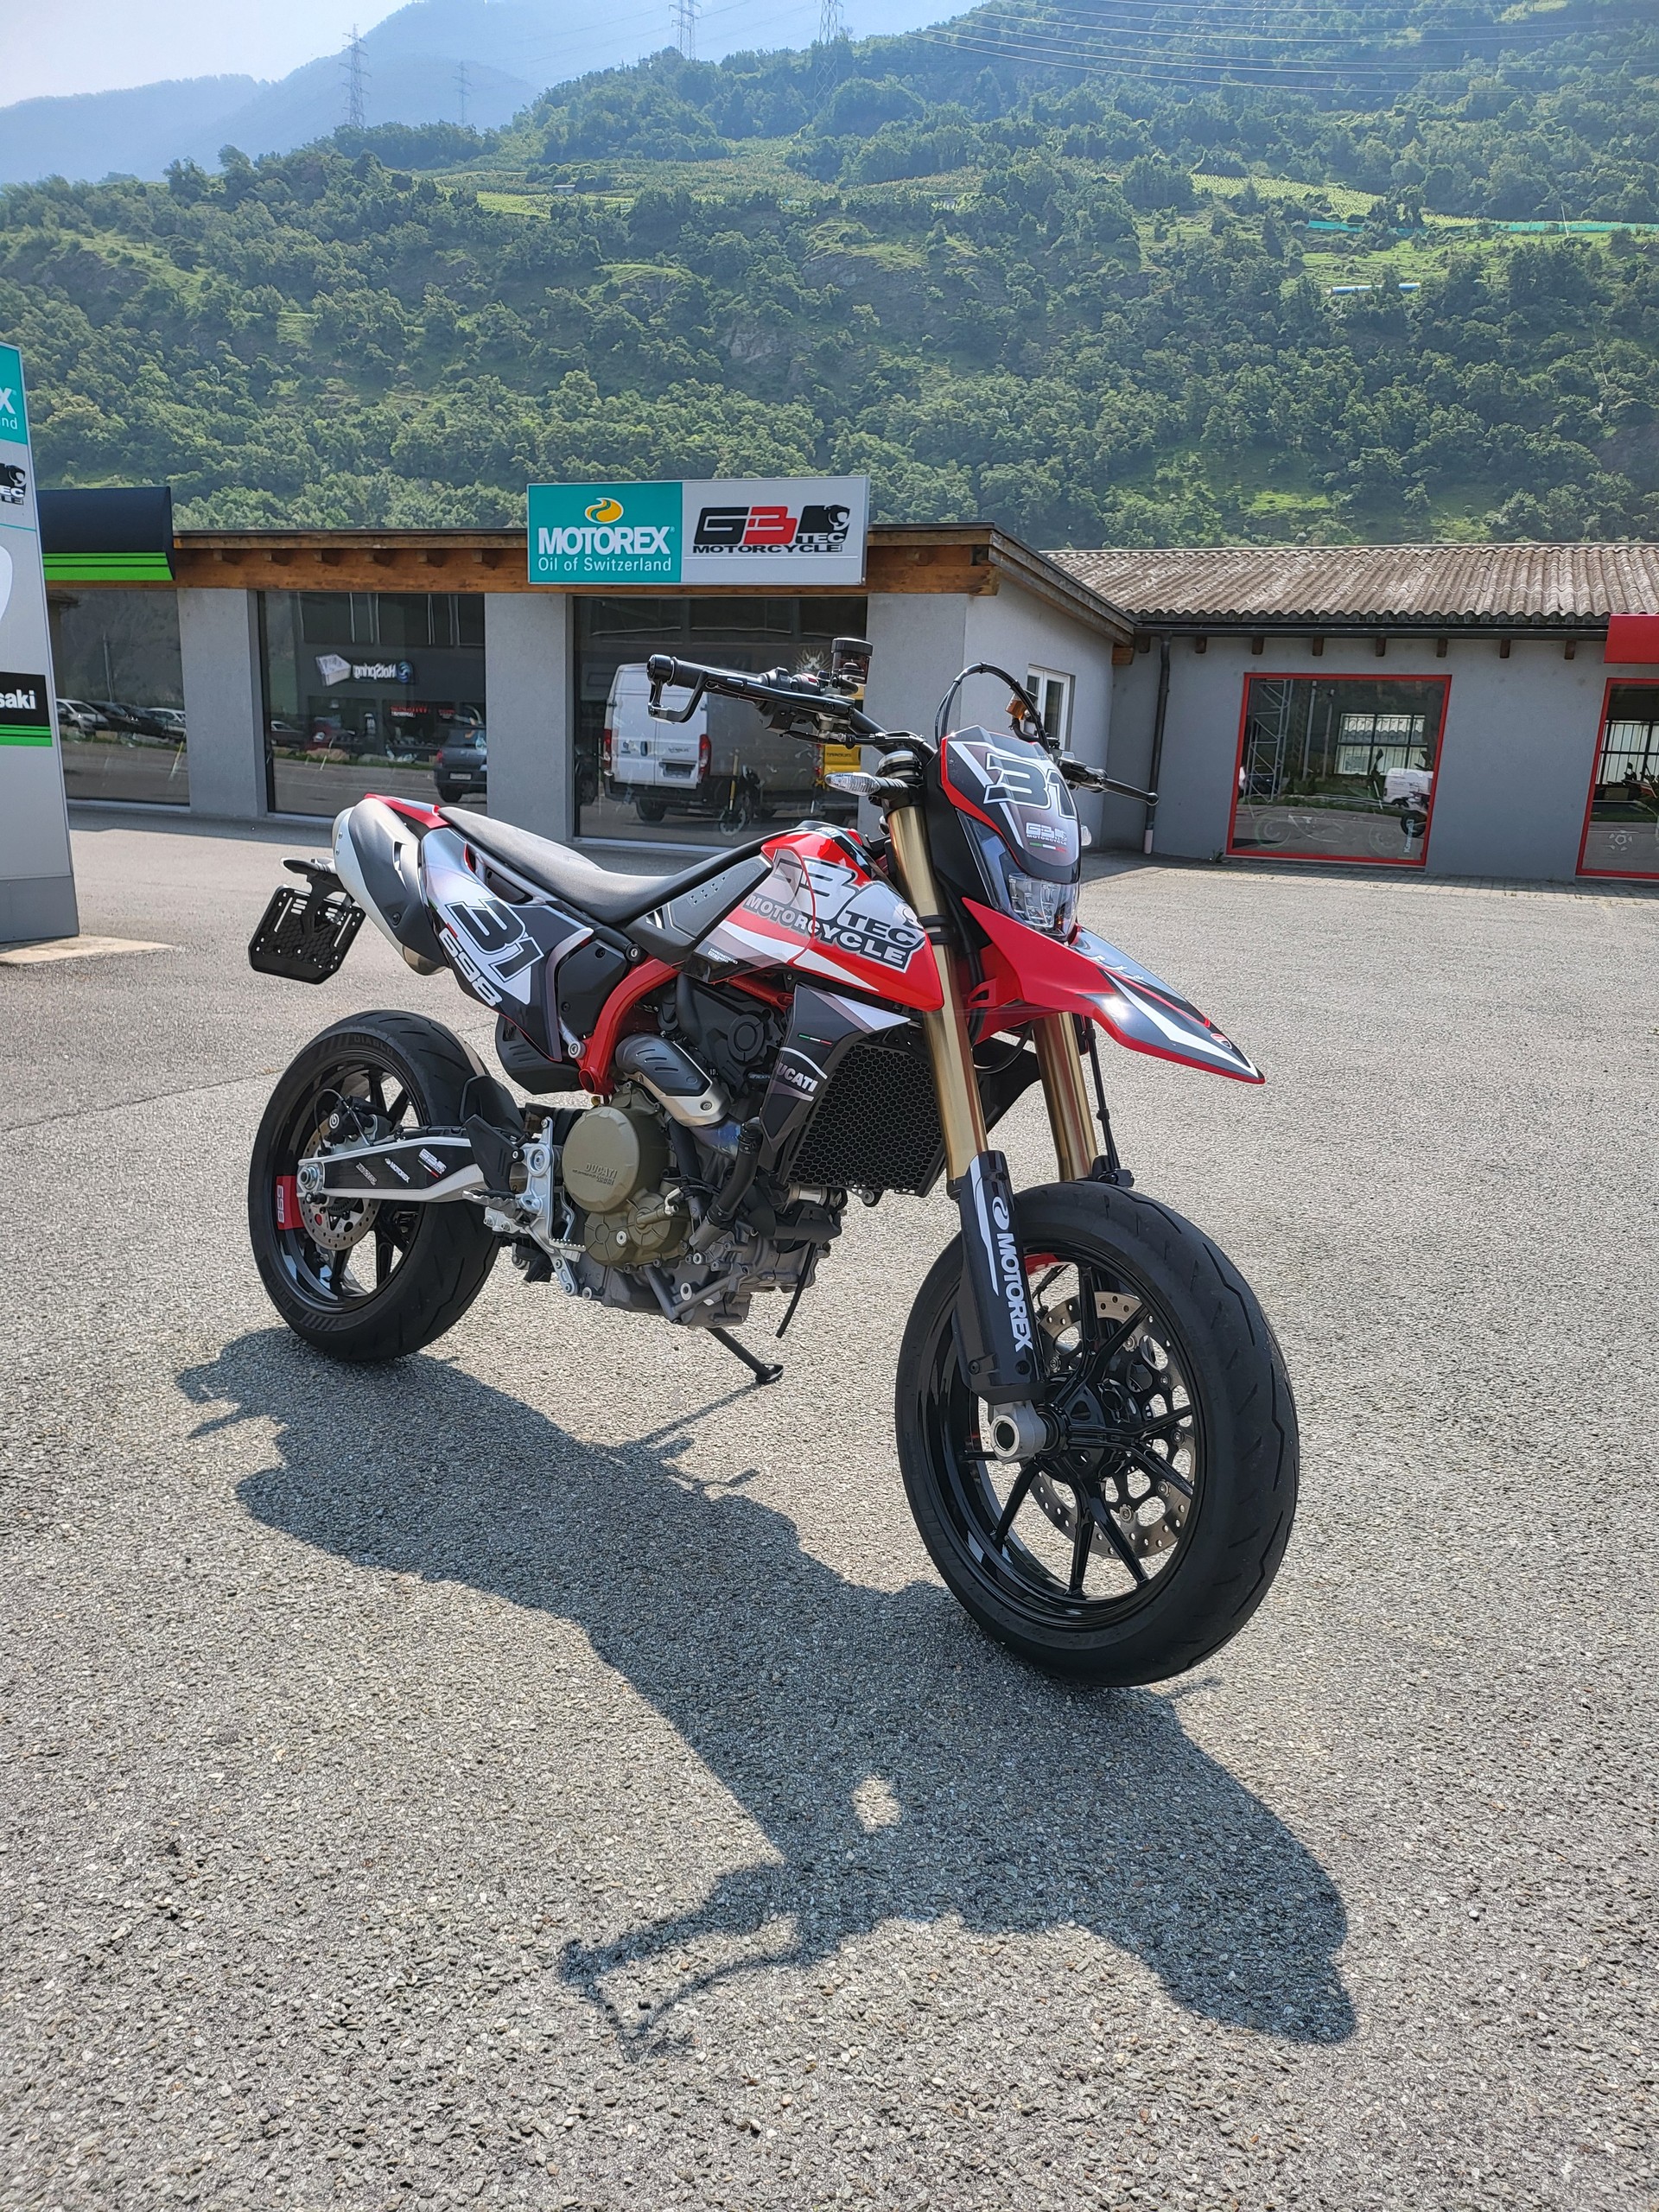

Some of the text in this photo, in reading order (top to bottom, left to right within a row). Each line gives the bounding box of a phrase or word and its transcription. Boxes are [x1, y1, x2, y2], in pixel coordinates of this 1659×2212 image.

[538, 526, 671, 555] MOTOREX
[692, 544, 841, 554] MOTORCYCLE
[797, 532, 845, 543] TEC
[538, 557, 671, 571] Oil of Switzerland
[444, 897, 544, 982] 31
[745, 895, 906, 966] MOTORCYCLE
[844, 910, 917, 947] TEC
[438, 927, 503, 1007] 698
[777, 1062, 818, 1092] UCATI
[586, 1162, 618, 1179] DUCATI
[996, 1233, 1033, 1353] MOTOREX
